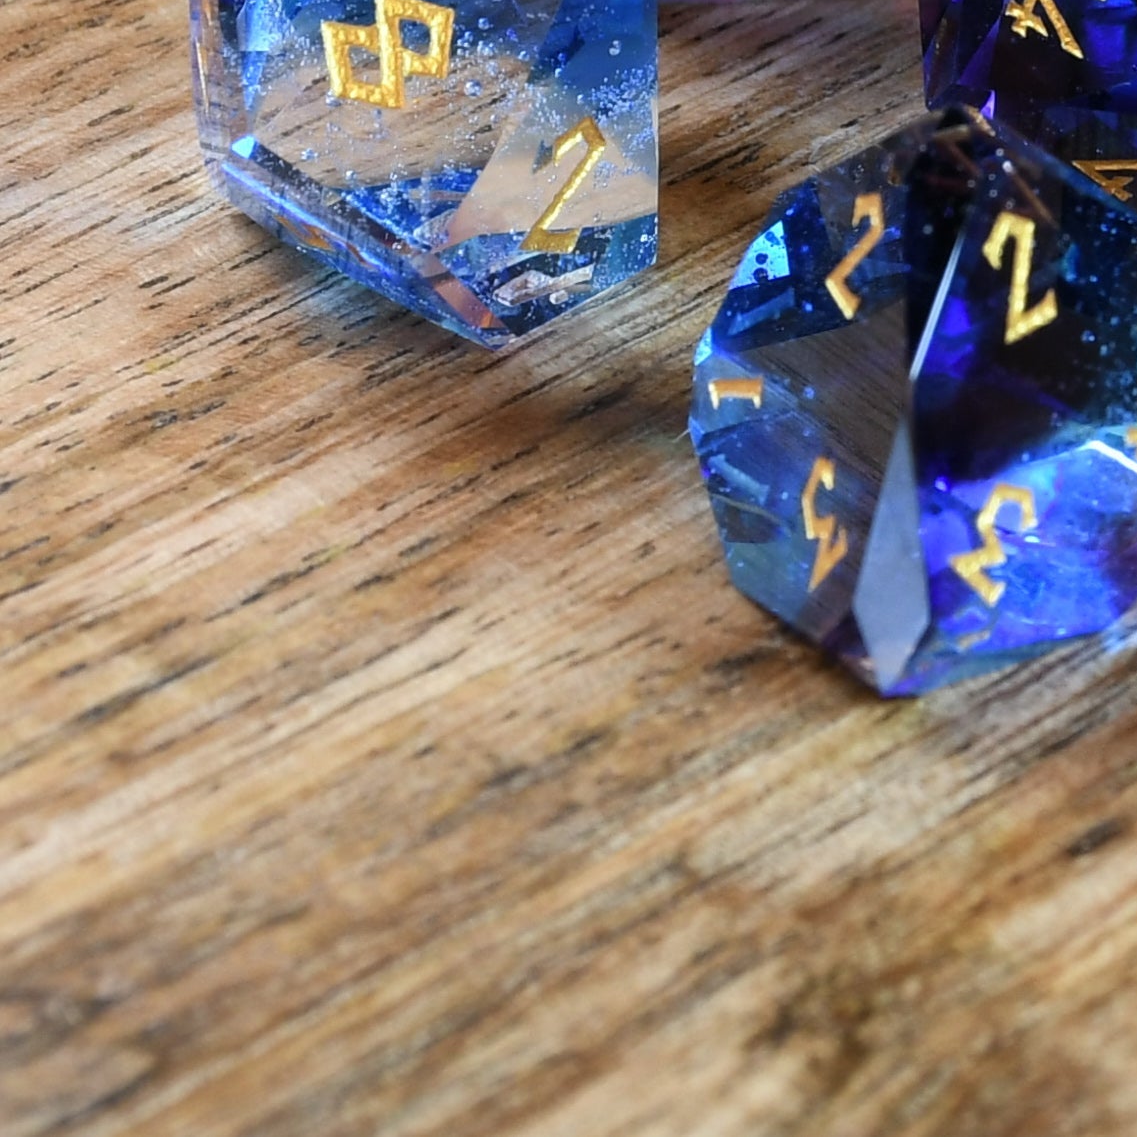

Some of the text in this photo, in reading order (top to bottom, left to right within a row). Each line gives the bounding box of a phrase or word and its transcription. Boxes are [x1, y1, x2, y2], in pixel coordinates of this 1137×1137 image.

[520, 116, 606, 252] 2
[825, 193, 884, 319] 2
[983, 212, 1058, 345] 2
[950, 484, 1037, 605] 3
